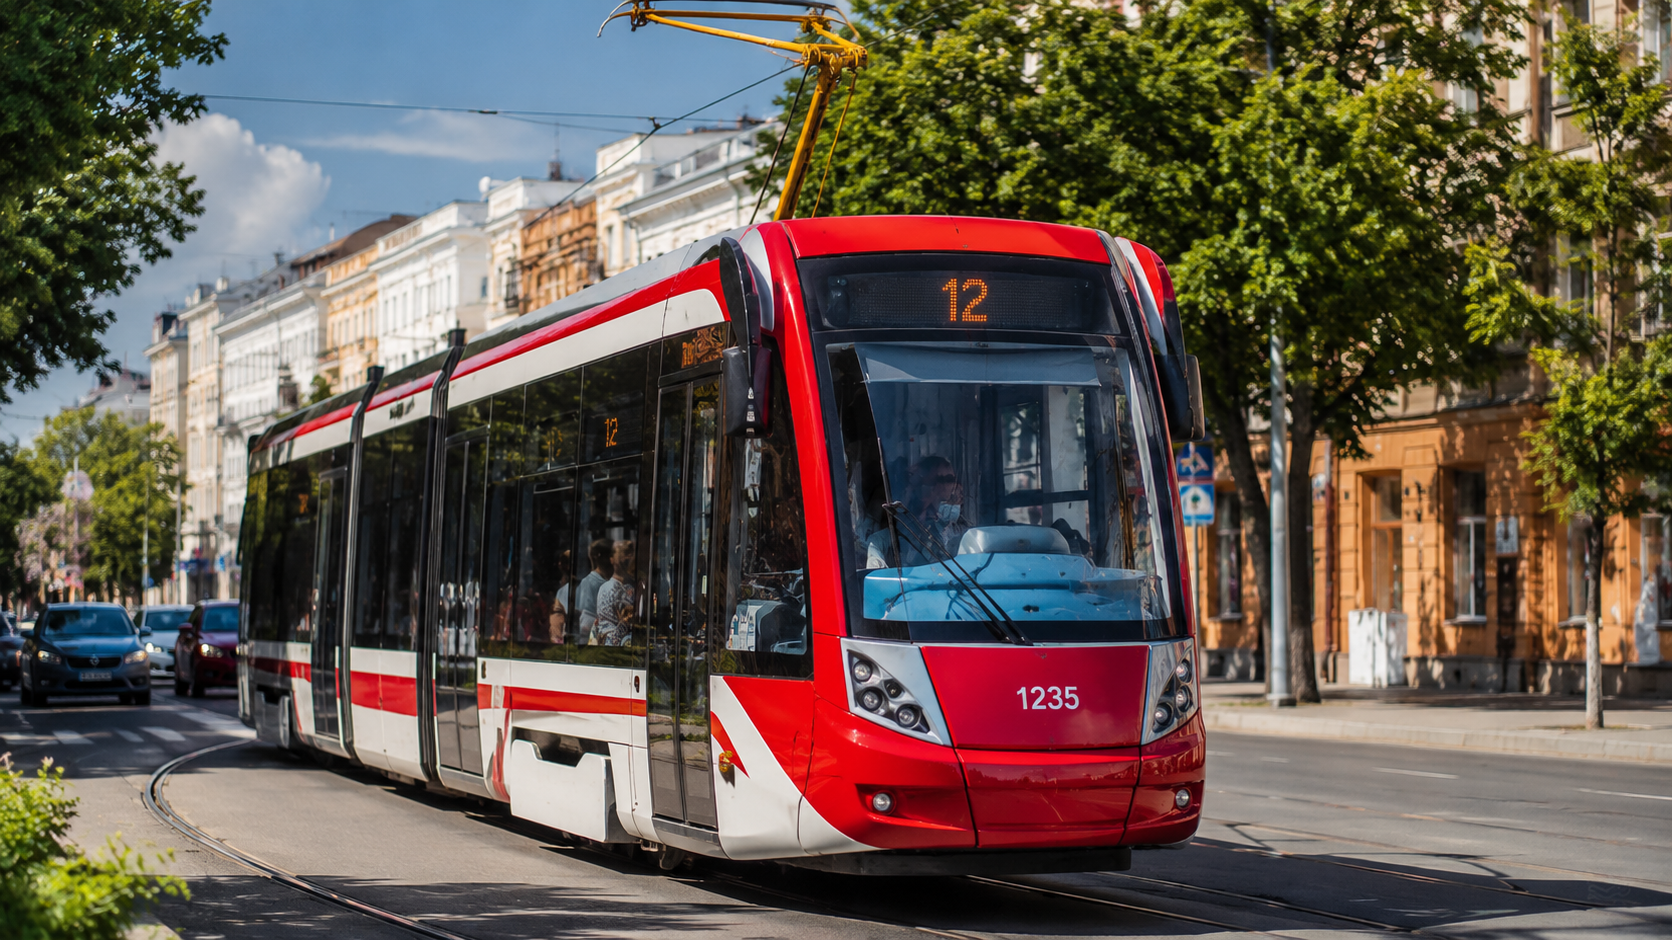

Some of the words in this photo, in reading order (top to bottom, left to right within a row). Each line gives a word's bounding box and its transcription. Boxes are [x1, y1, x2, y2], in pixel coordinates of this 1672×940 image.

[942, 278, 988, 322] 12
[604, 417, 618, 448] 12
[1016, 685, 1080, 710] 1235
